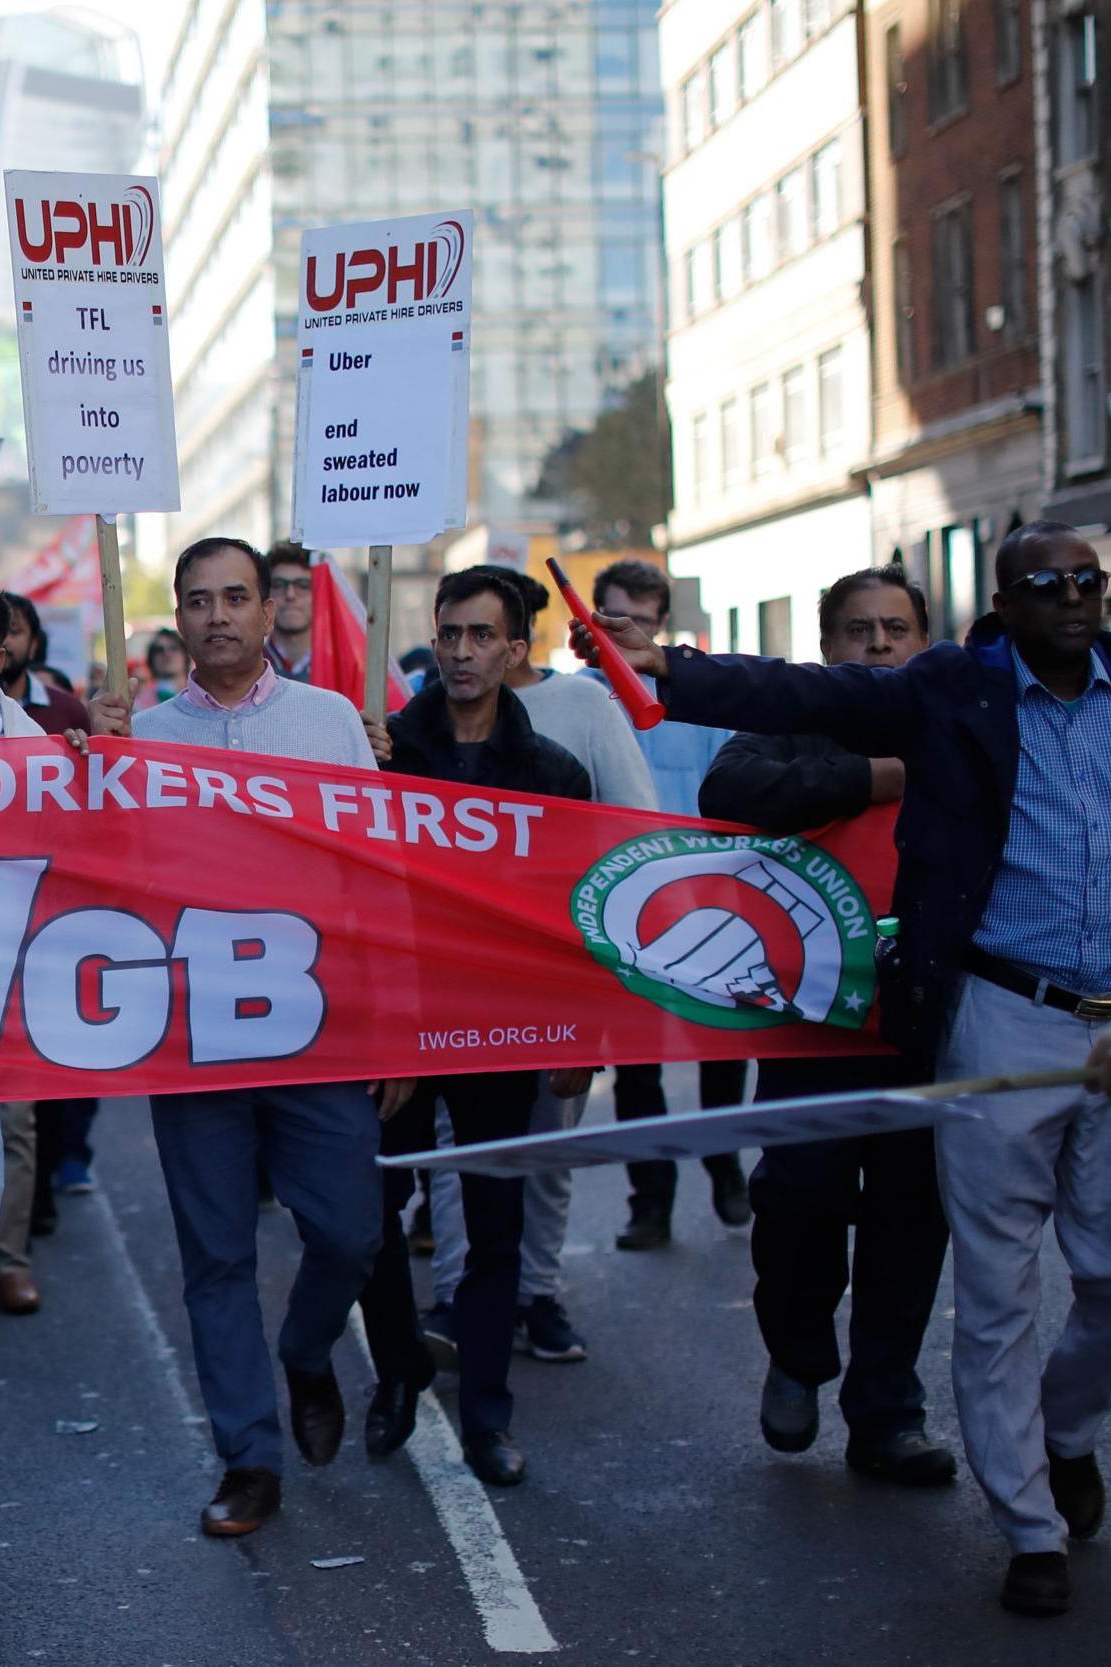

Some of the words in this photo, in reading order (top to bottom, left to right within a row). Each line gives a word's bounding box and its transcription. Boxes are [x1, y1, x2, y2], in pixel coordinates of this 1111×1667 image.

[21, 268, 55, 281] UNITED
[57, 269, 95, 282] PRIVATE
[97, 271, 118, 283] HIRE
[120, 272, 159, 284] DRIVERS
[76, 307, 111, 331] TFL
[304, 315, 342, 329] UNITED
[345, 310, 388, 324] PRIVATE
[391, 306, 414, 319] HIRE
[418, 301, 463, 316] DRIVERS
[48, 350, 117, 381] driving
[123, 358, 145, 376] us
[329, 351, 372, 371] Uber
[80, 403, 120, 428] into
[325, 419, 358, 439] end
[62, 453, 144, 481] poverty
[323, 448, 398, 471] sweated
[322, 484, 380, 503] labour
[384, 482, 420, 499] now
[319, 783, 544, 857] FIRST
[576, 836, 675, 945] INDEPENDENT
[805, 856, 869, 940] UNION
[418, 1024, 577, 1050] IWGB.ORG.UK
